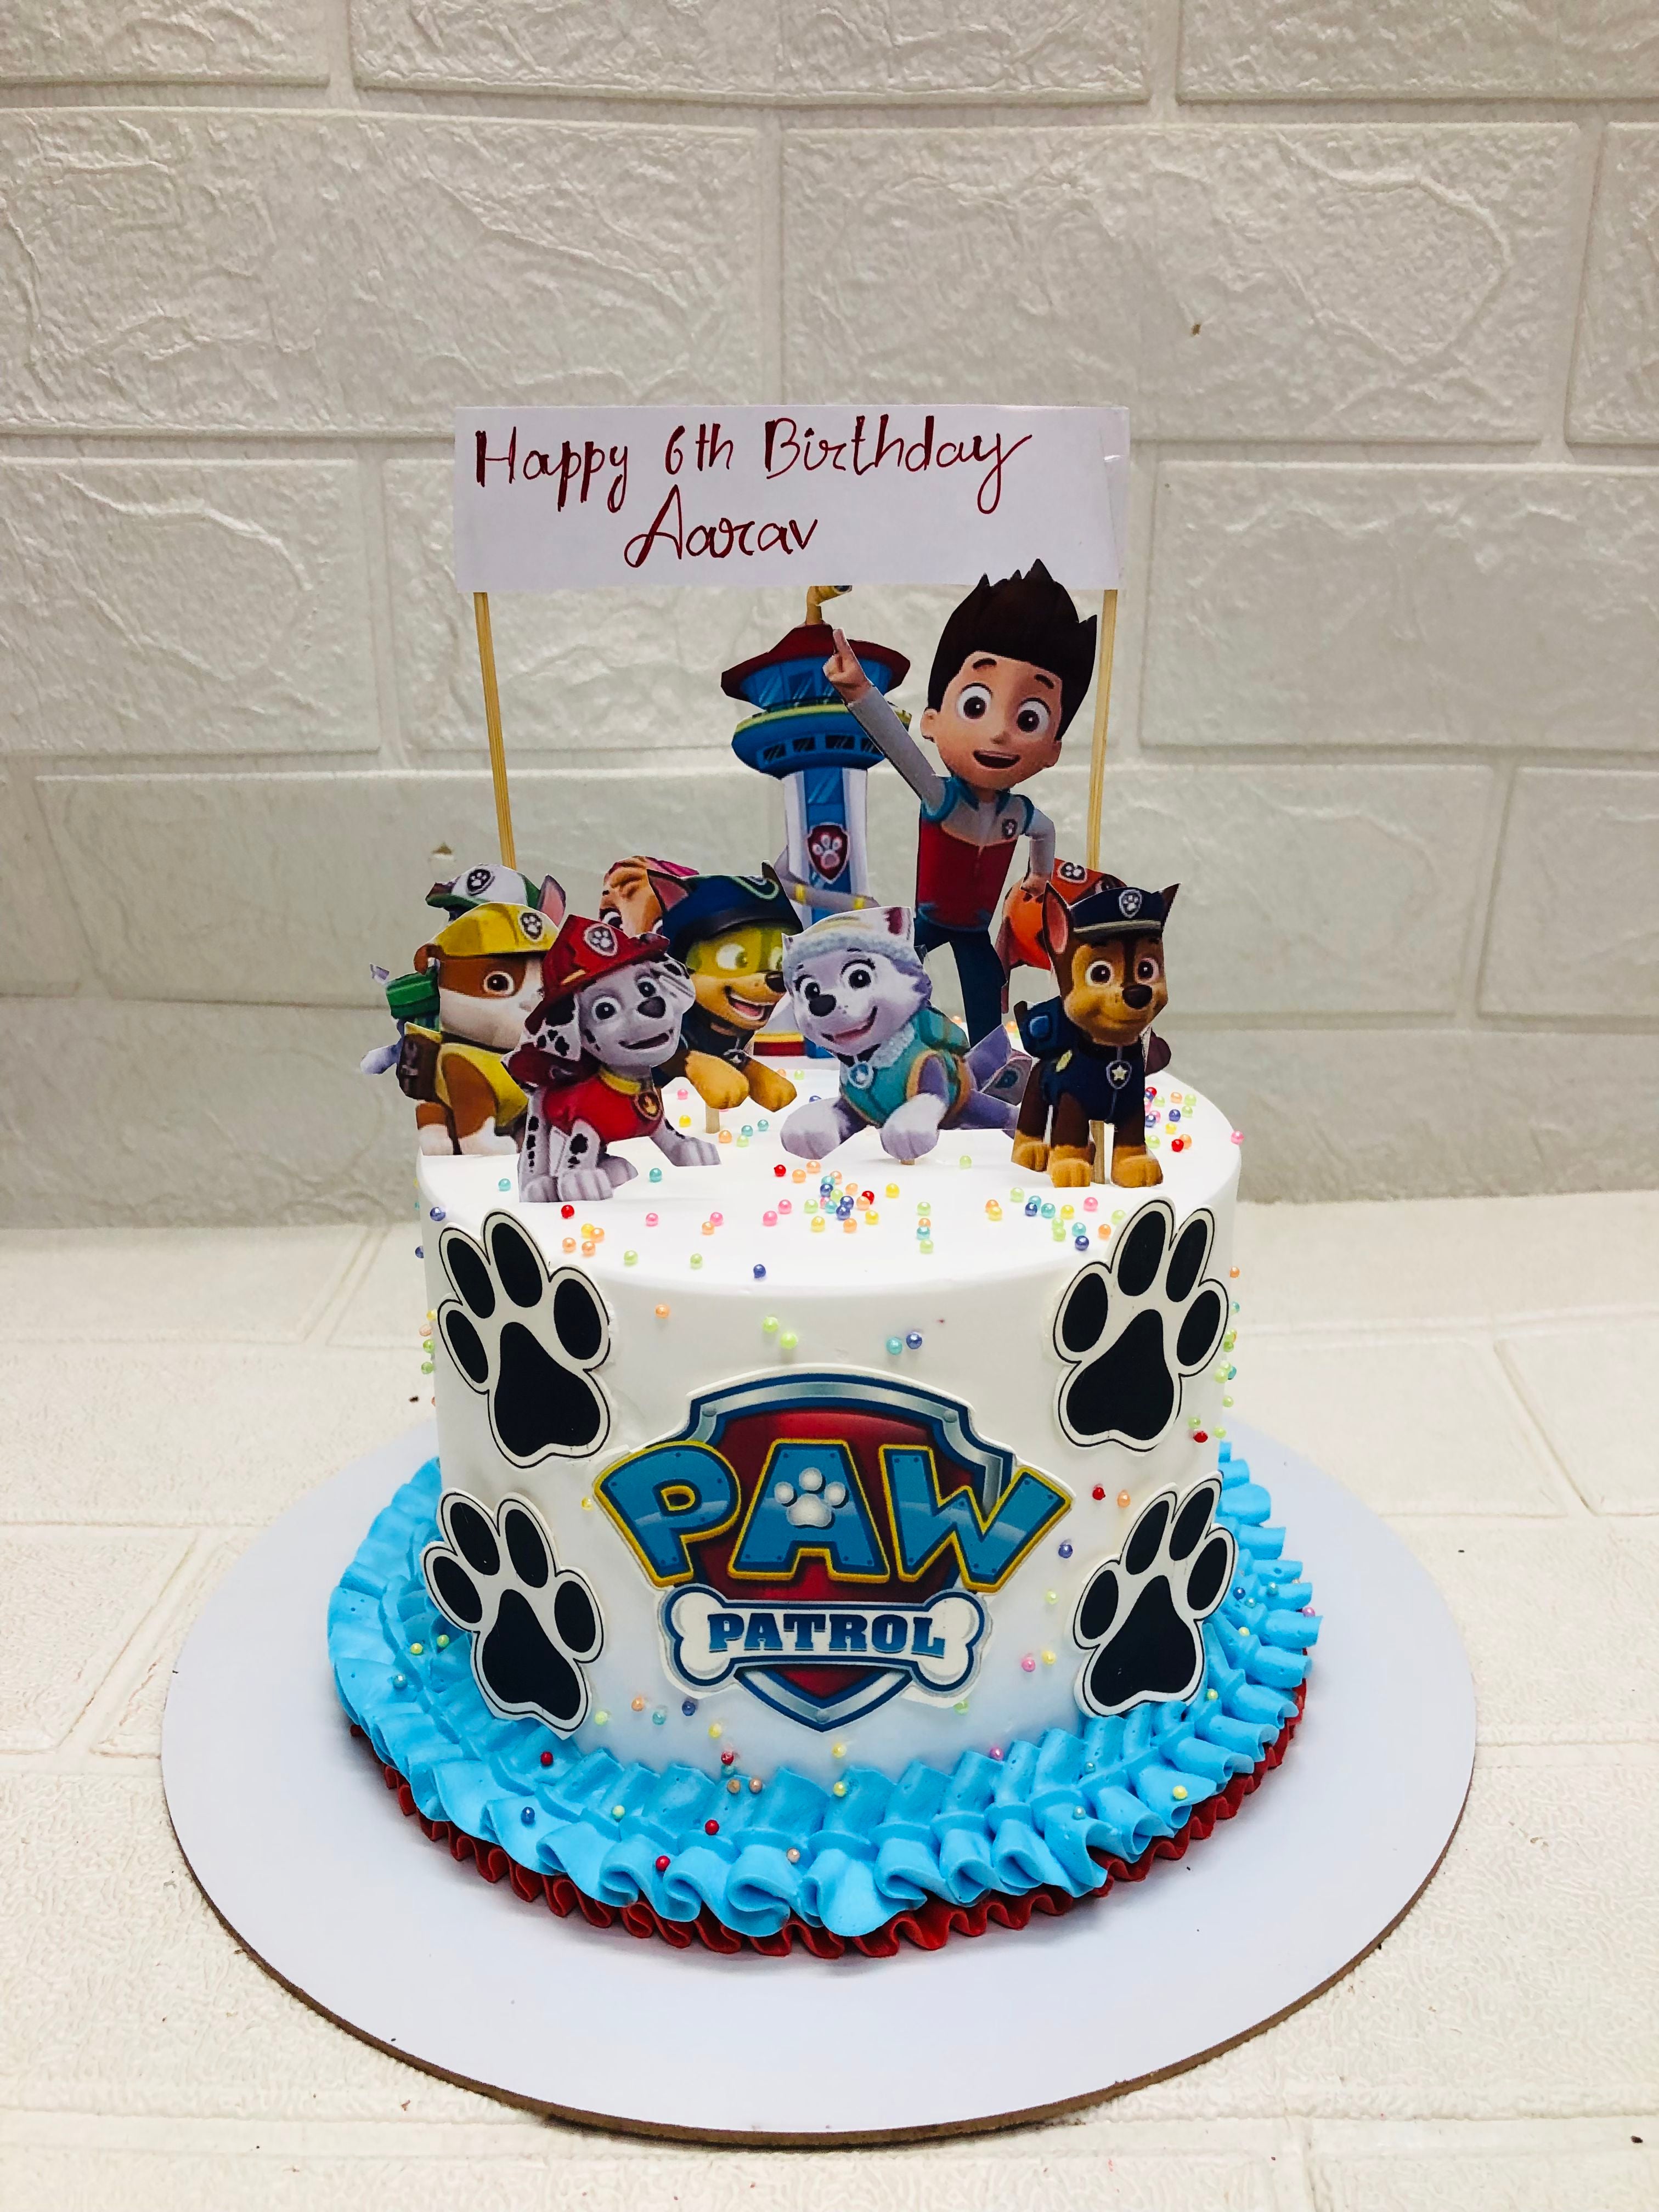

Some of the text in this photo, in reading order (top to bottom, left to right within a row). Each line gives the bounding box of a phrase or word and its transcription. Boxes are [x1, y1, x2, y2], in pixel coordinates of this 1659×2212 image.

[475, 414, 1032, 514] Happy 6th Birthday
[624, 484, 818, 567] Aarav
[593, 1438, 1073, 1593] PAW
[707, 1612, 946, 1658] PATROL
